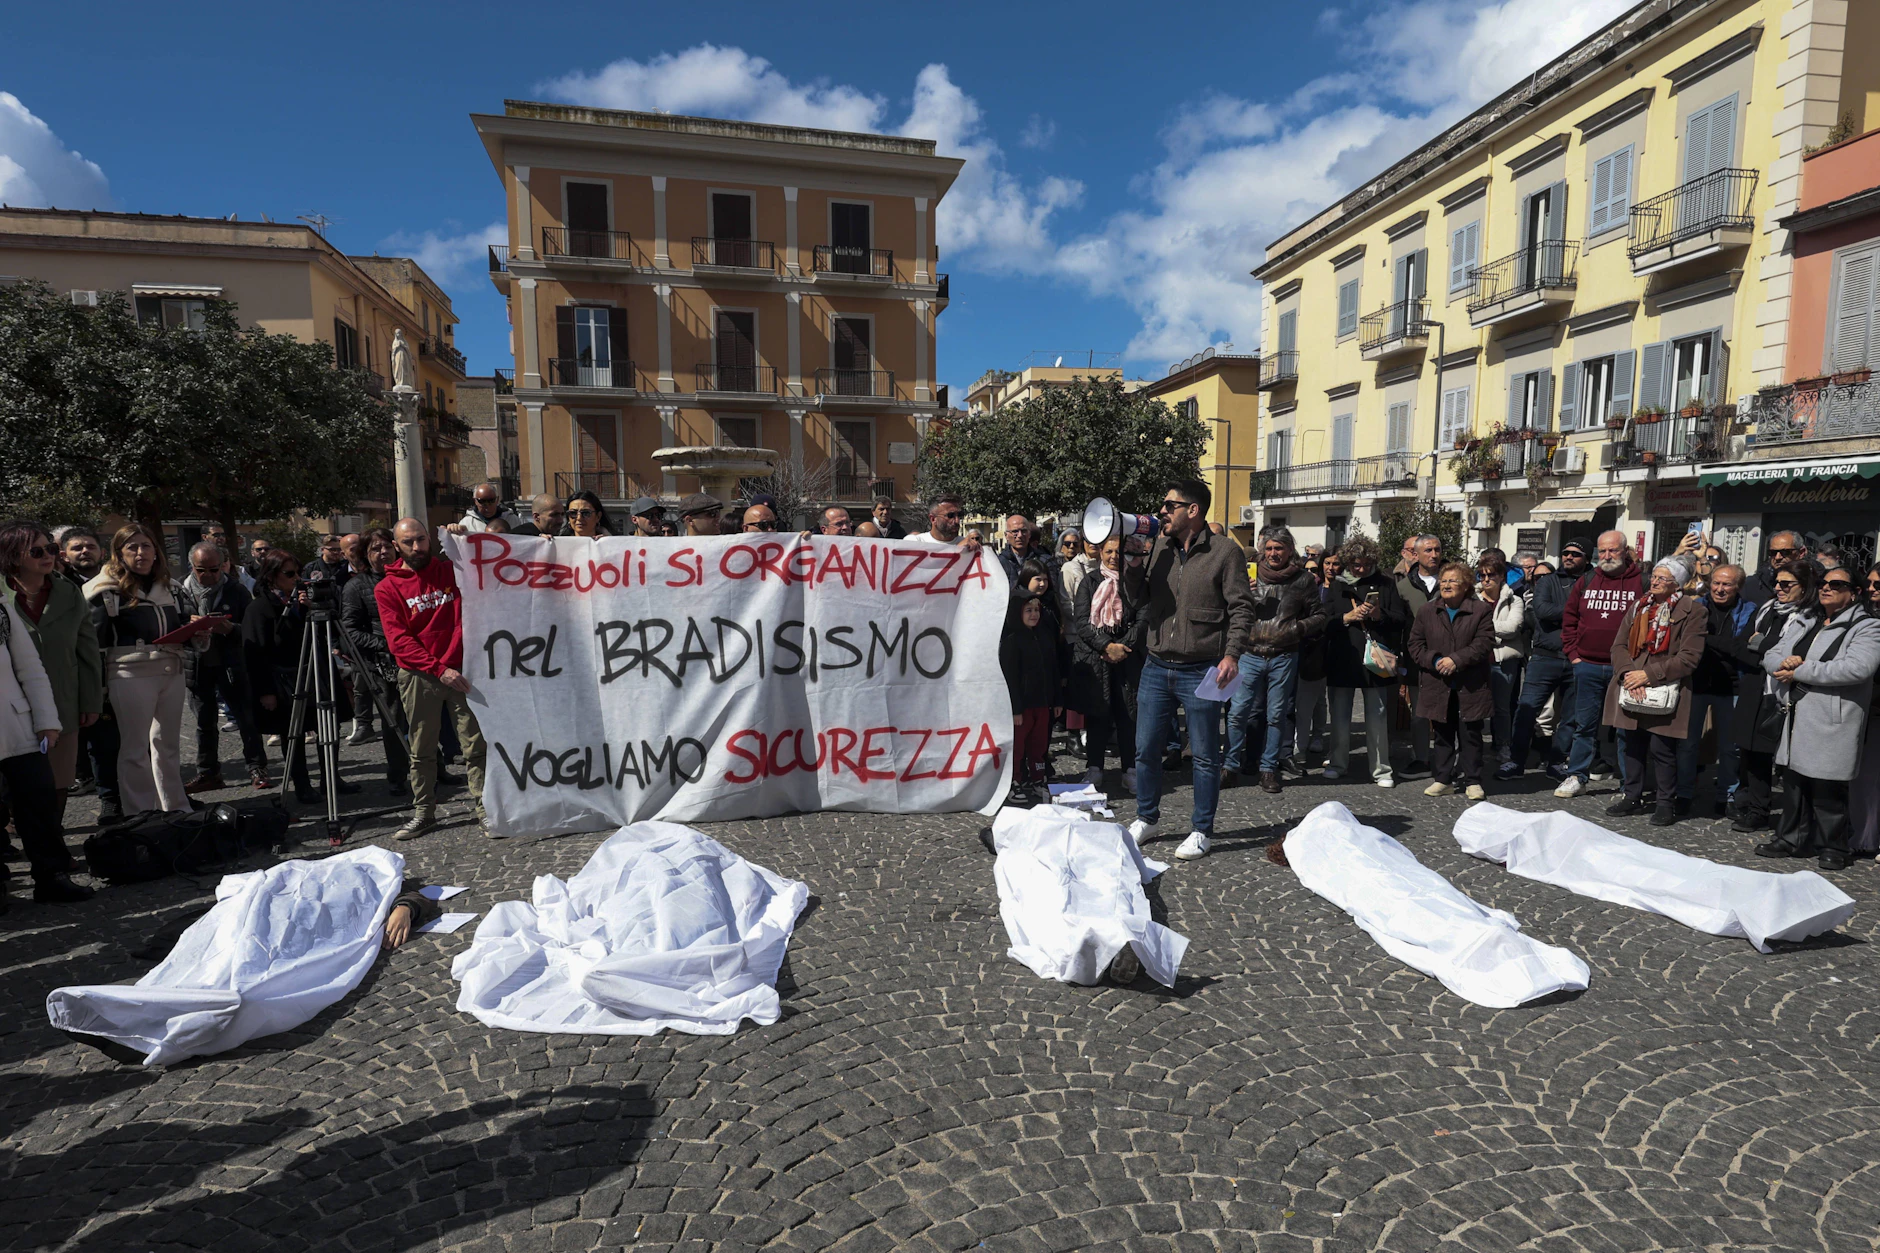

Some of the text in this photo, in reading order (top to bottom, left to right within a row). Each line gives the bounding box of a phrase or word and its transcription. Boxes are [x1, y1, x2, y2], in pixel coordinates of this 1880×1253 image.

[1726, 464, 1858, 481] MACELLERIA DI FRANCIA
[1762, 481, 1869, 504] Macelleria
[467, 533, 646, 593] Pozzuoli
[719, 541, 991, 595] ORGANIZZA
[1584, 589, 1635, 601] BROTHER
[1587, 600, 1627, 611] HOODS
[484, 616, 953, 688] nel BRADISISMO
[494, 722, 1002, 792] VOGLIAMO SICUREZZA
